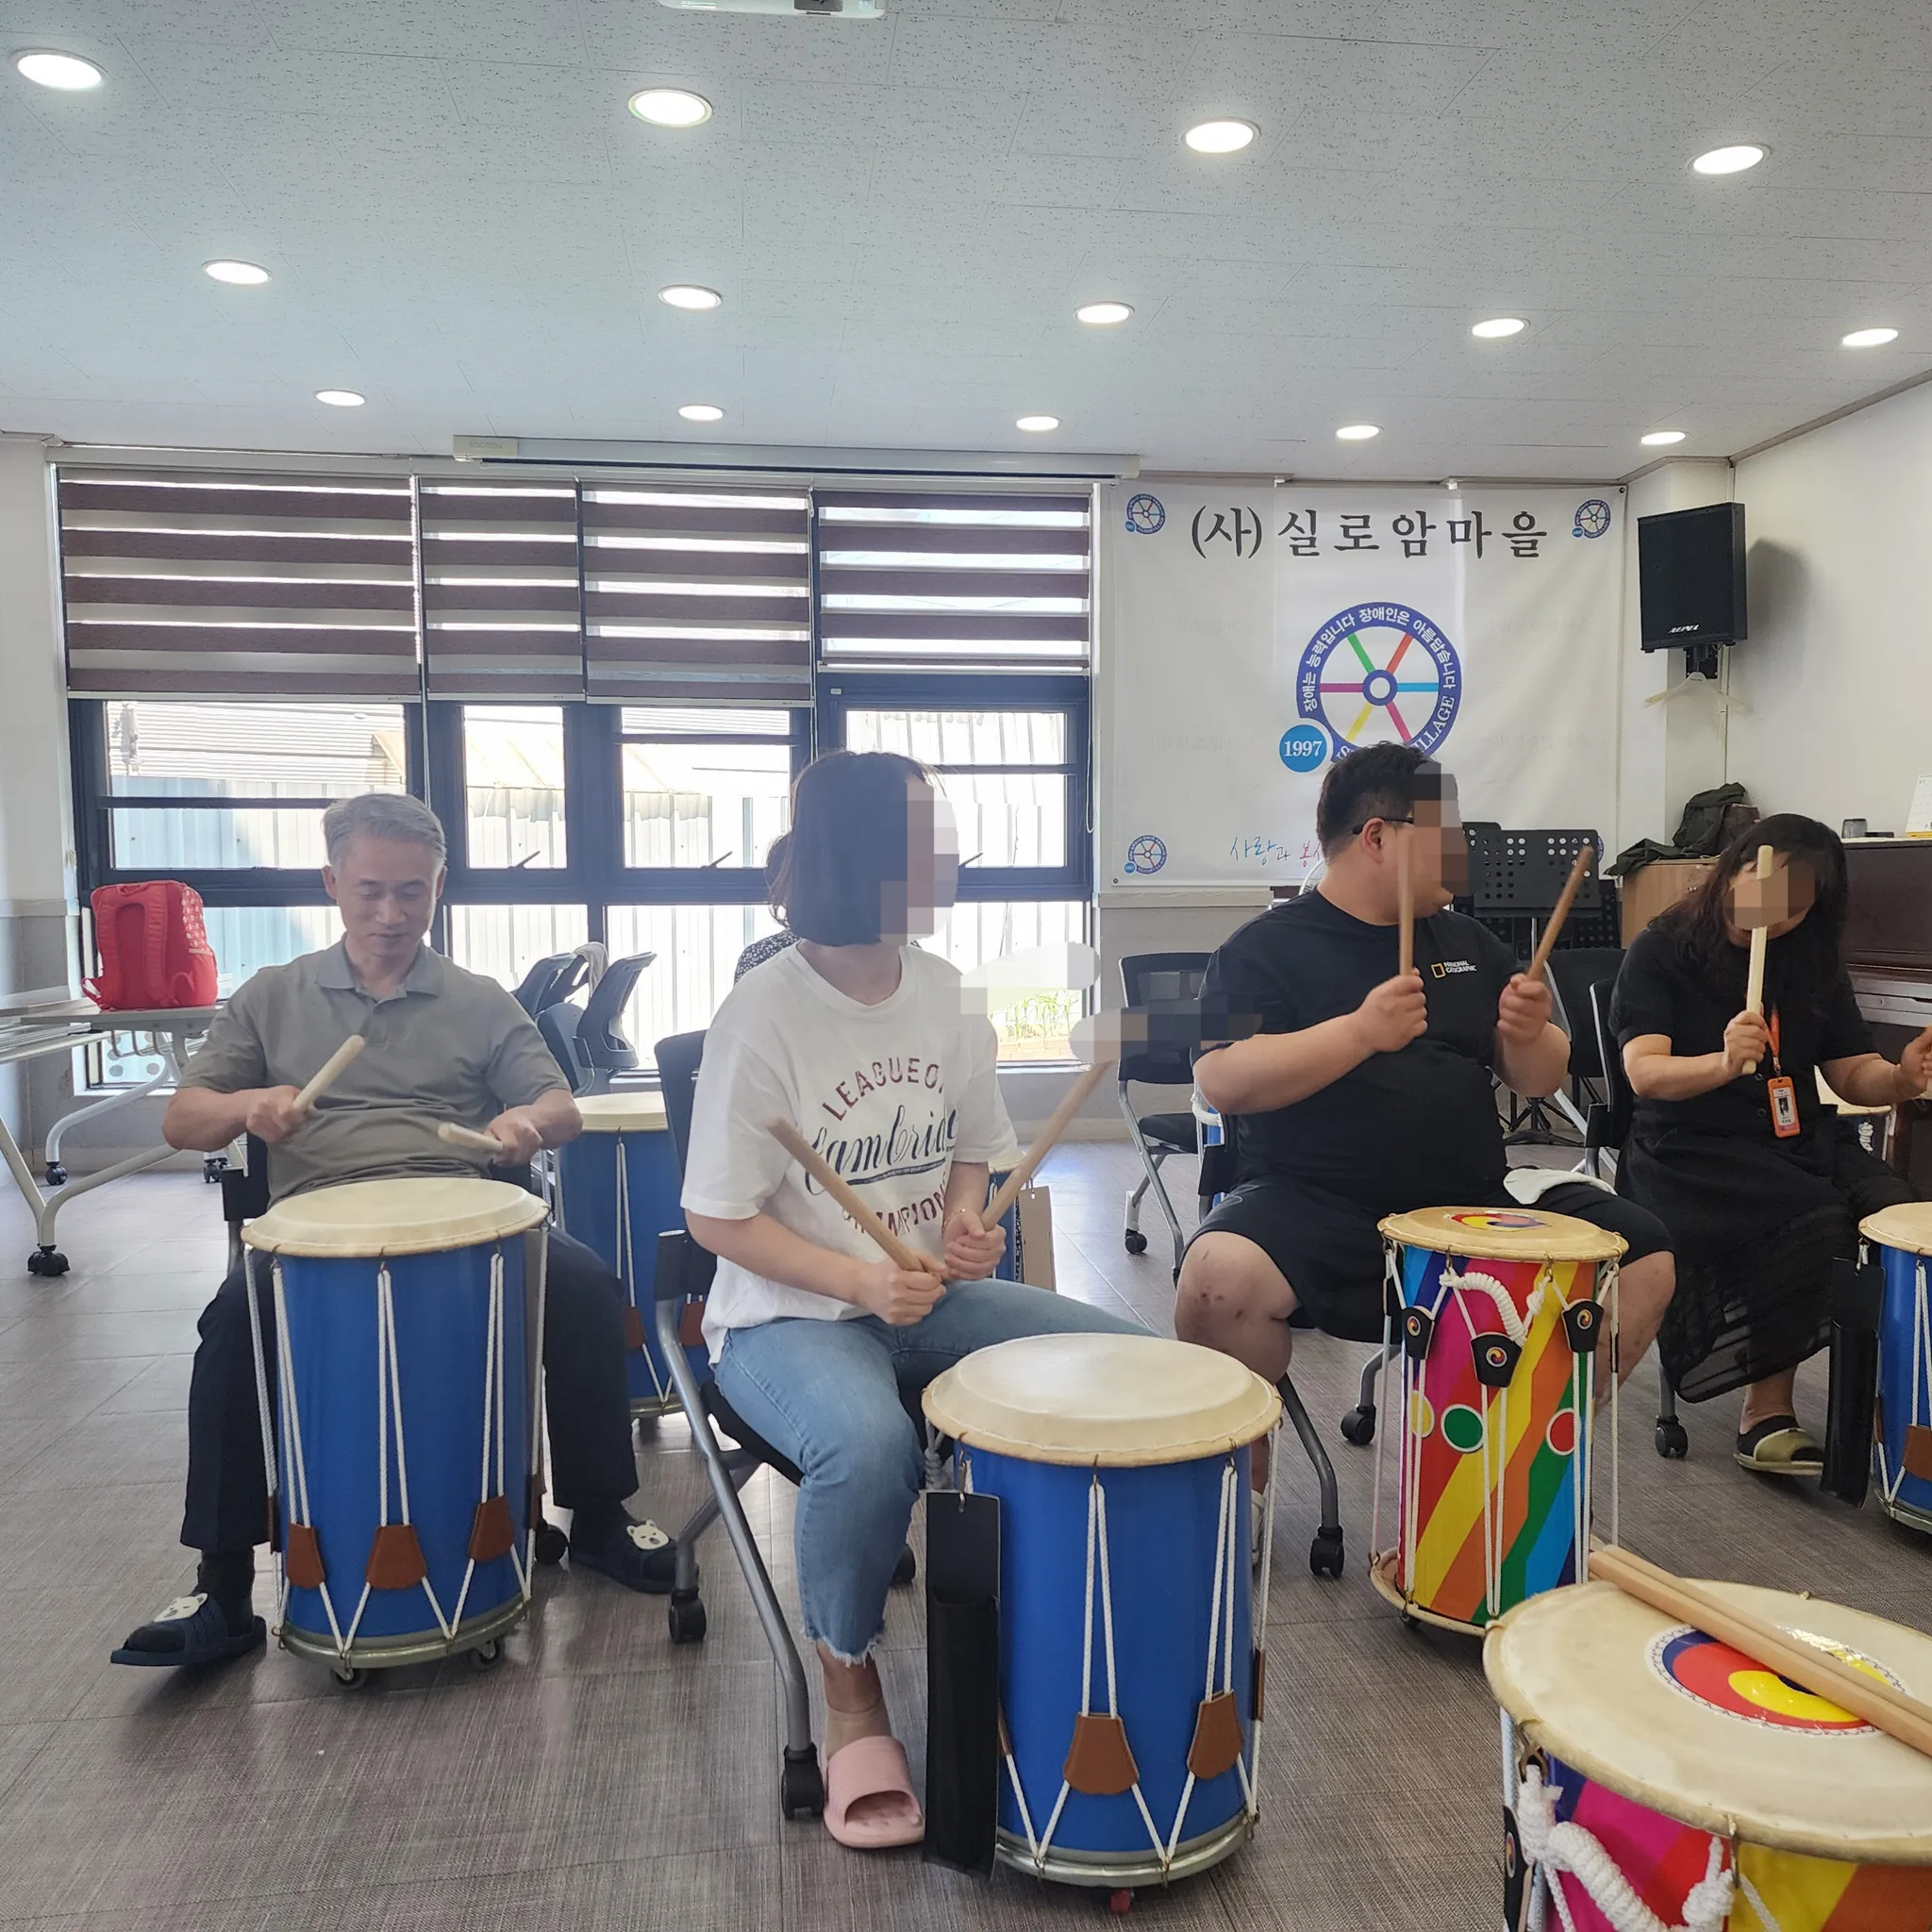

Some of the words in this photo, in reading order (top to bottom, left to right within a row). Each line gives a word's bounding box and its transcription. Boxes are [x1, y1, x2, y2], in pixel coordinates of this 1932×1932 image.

[1358, 607, 1411, 626] 장애인은
[1306, 613, 1356, 668] 능력입니다
[1412, 619, 1457, 690] 아름답습니다
[1302, 672, 1318, 712] 장애는
[1283, 740, 1323, 758] 1997
